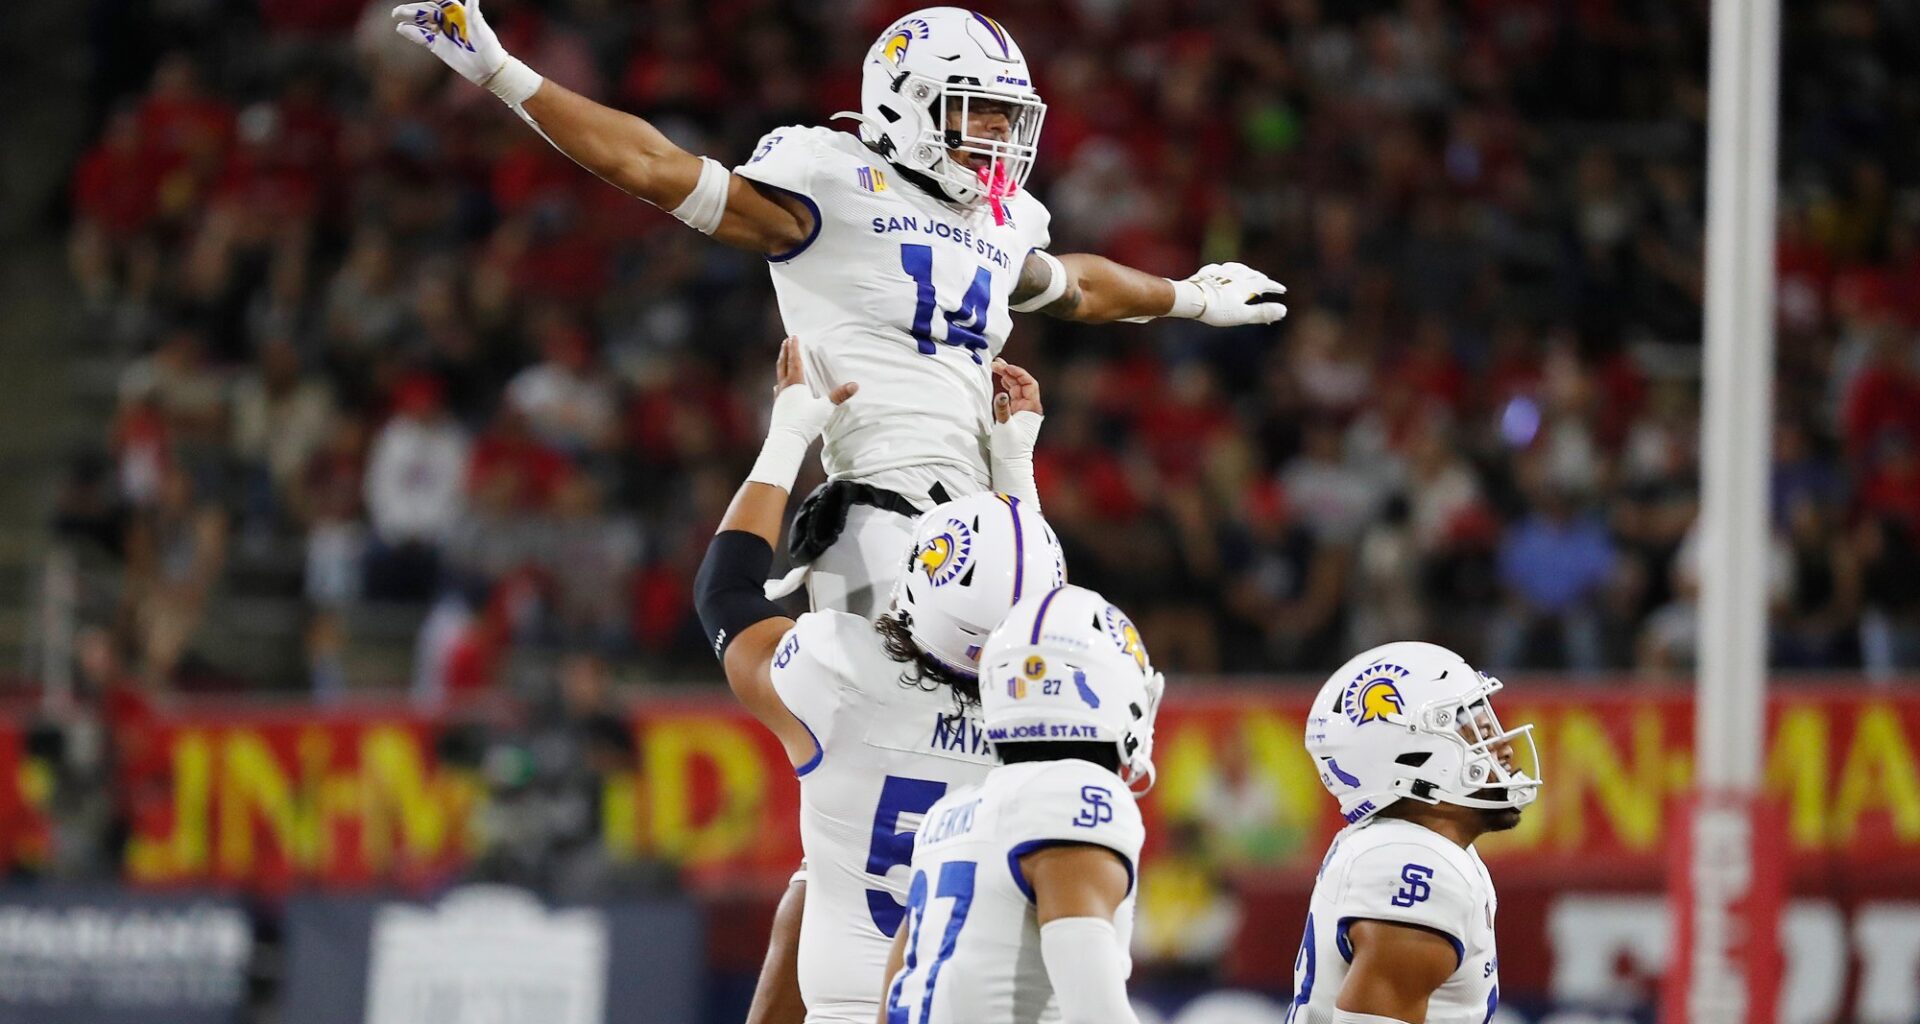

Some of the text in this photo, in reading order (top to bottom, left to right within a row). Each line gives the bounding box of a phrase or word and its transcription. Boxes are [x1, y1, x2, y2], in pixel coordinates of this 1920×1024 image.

[872, 216, 1012, 274] SAN JOSÉ STAT
[900, 243, 992, 366] 14
[1025, 661, 1044, 676] LF
[1042, 679, 1063, 695] 27
[987, 722, 1098, 740] SAN JOSÉ STATE
[864, 774, 948, 939] 5
